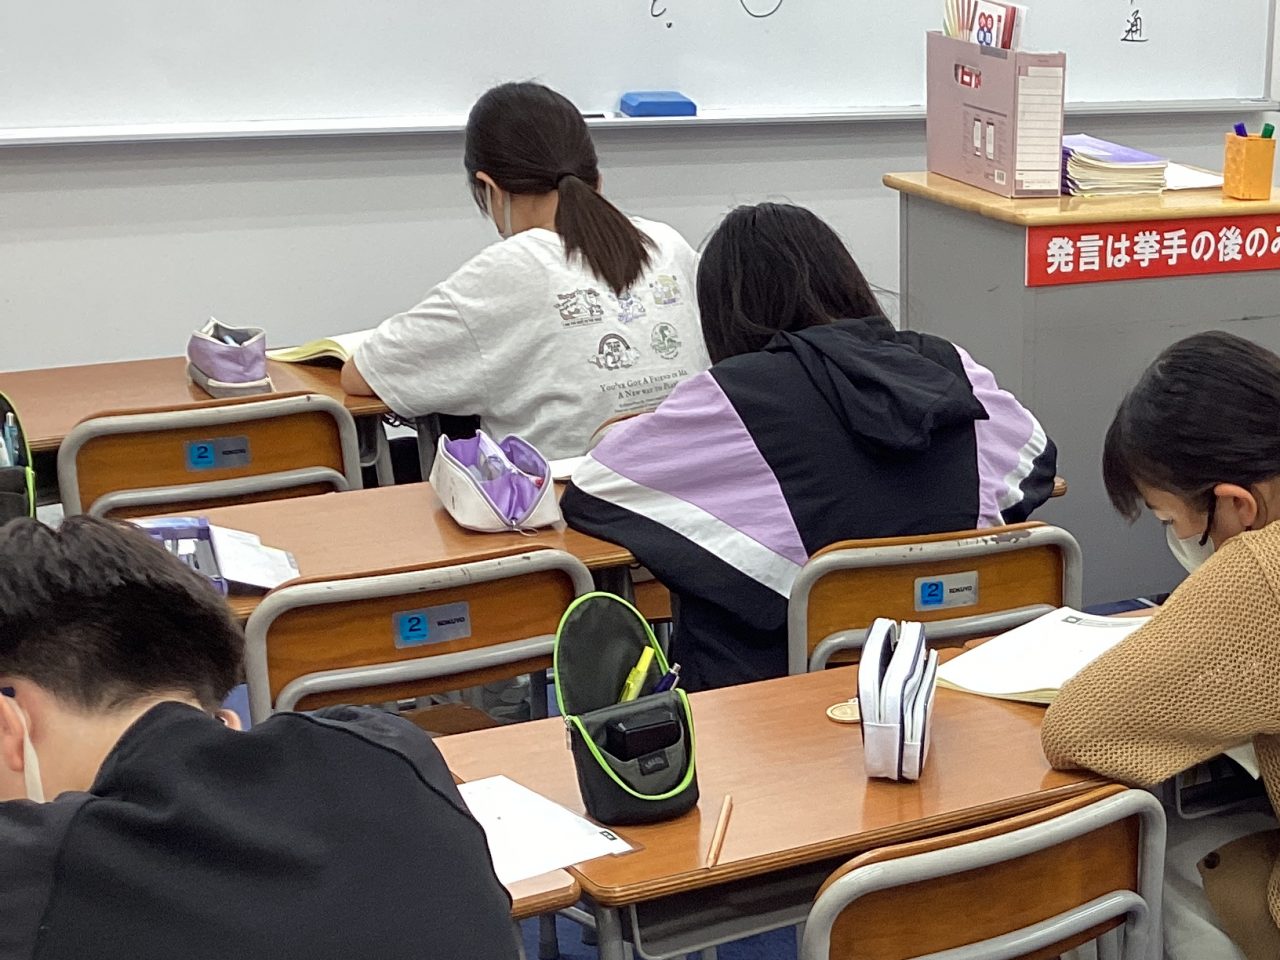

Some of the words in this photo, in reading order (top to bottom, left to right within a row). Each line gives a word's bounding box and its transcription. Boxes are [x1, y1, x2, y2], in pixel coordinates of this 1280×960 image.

[197, 445, 208, 459] 2
[927, 582, 939, 597] 2
[407, 616, 422, 632] 2
